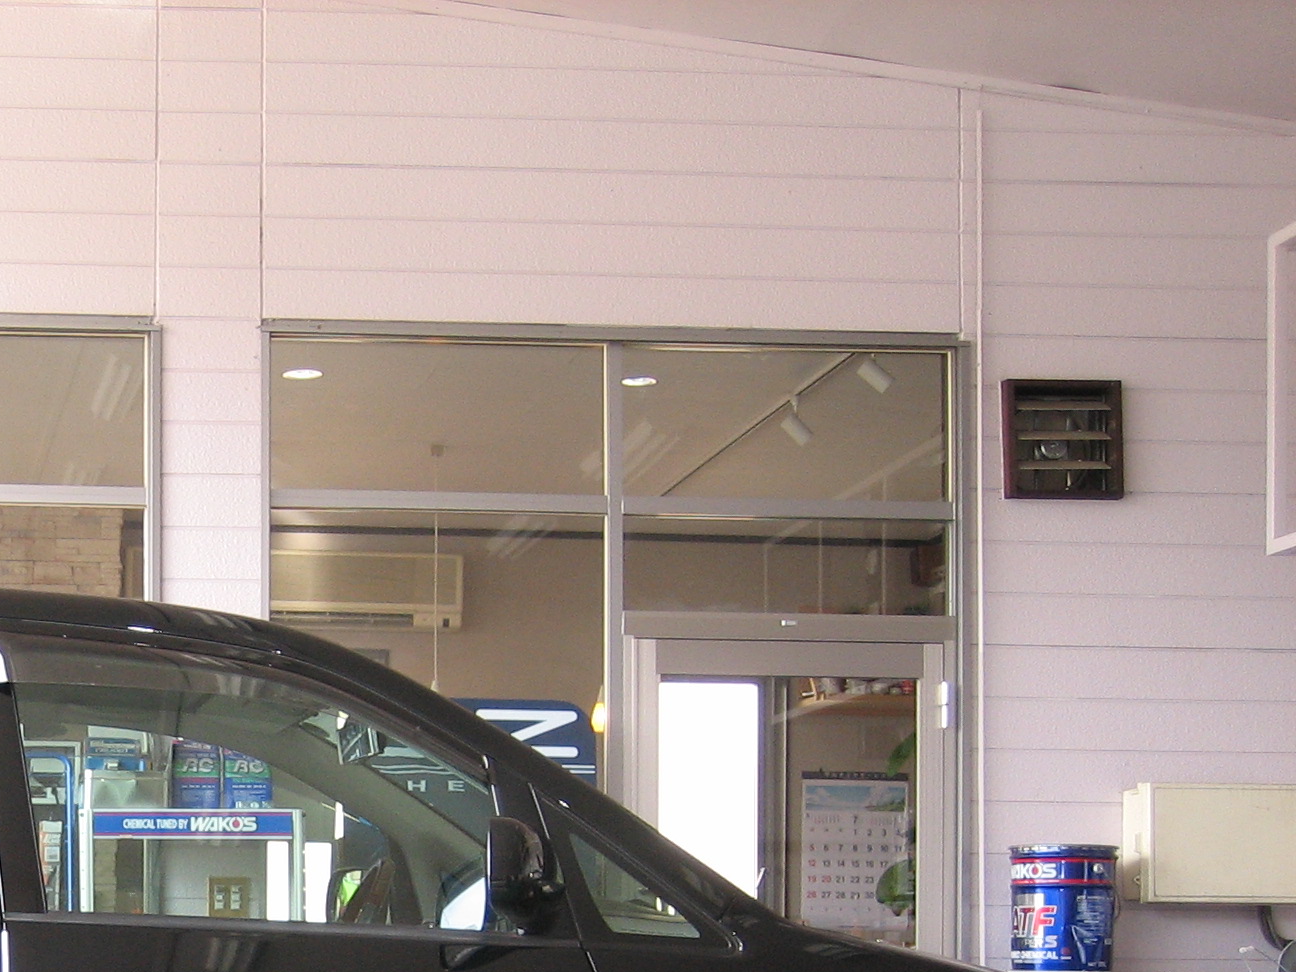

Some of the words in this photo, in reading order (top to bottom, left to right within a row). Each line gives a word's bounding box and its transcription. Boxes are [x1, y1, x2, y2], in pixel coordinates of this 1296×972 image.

[123, 818, 156, 829] CHEMICAL
[156, 818, 178, 829] TUNED
[178, 818, 188, 829] BY
